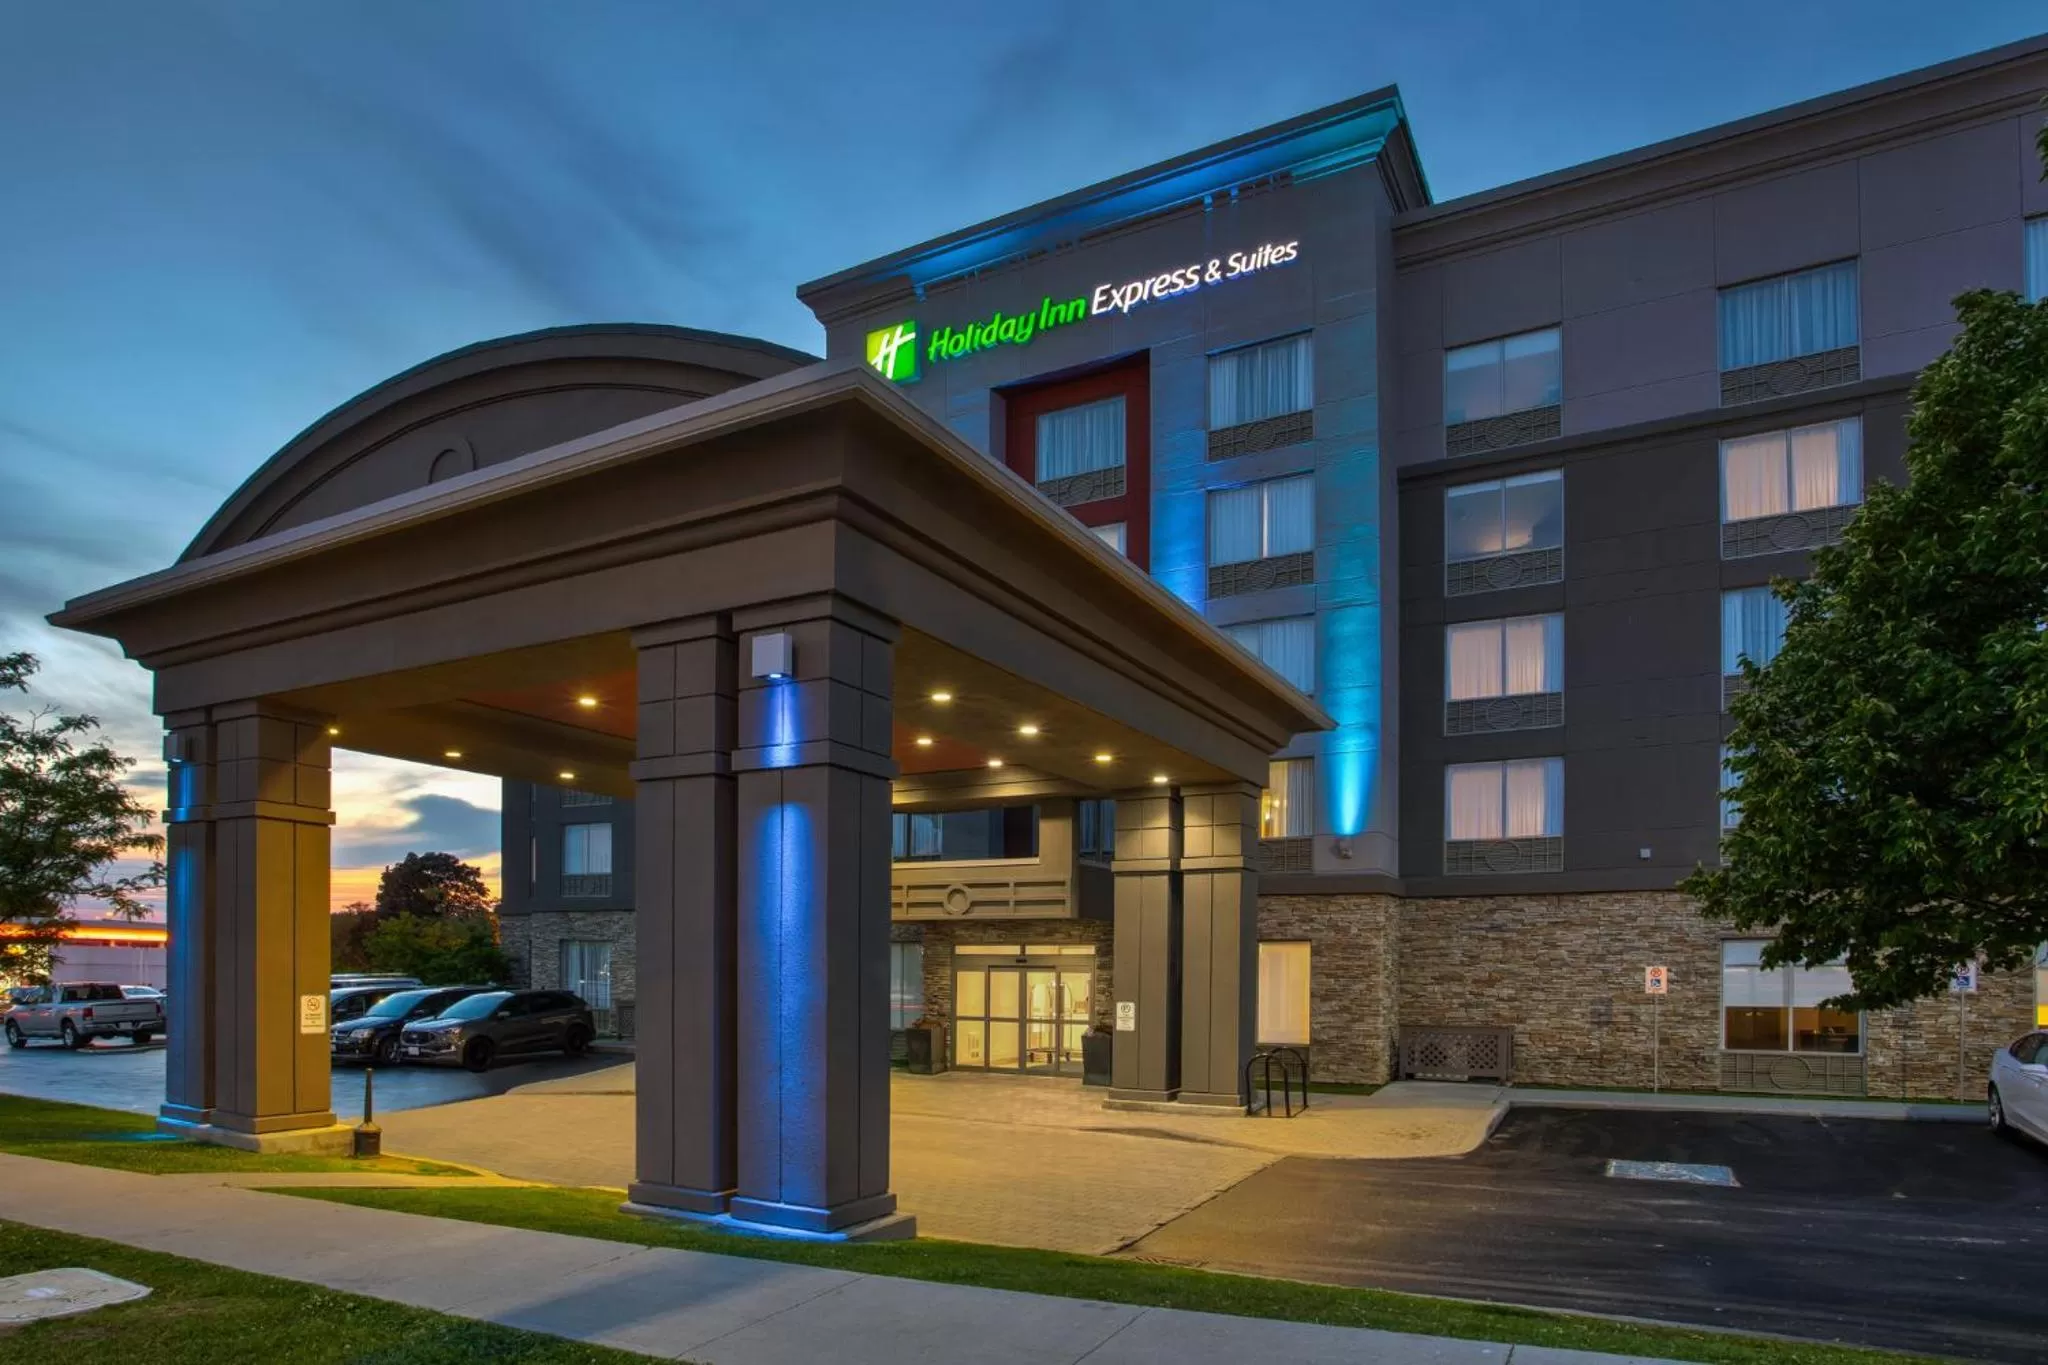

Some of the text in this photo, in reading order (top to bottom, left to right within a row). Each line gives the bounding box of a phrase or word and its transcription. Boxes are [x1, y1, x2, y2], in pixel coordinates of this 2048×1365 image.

[928, 241, 1299, 362] Holiday Inn Express & Suites
